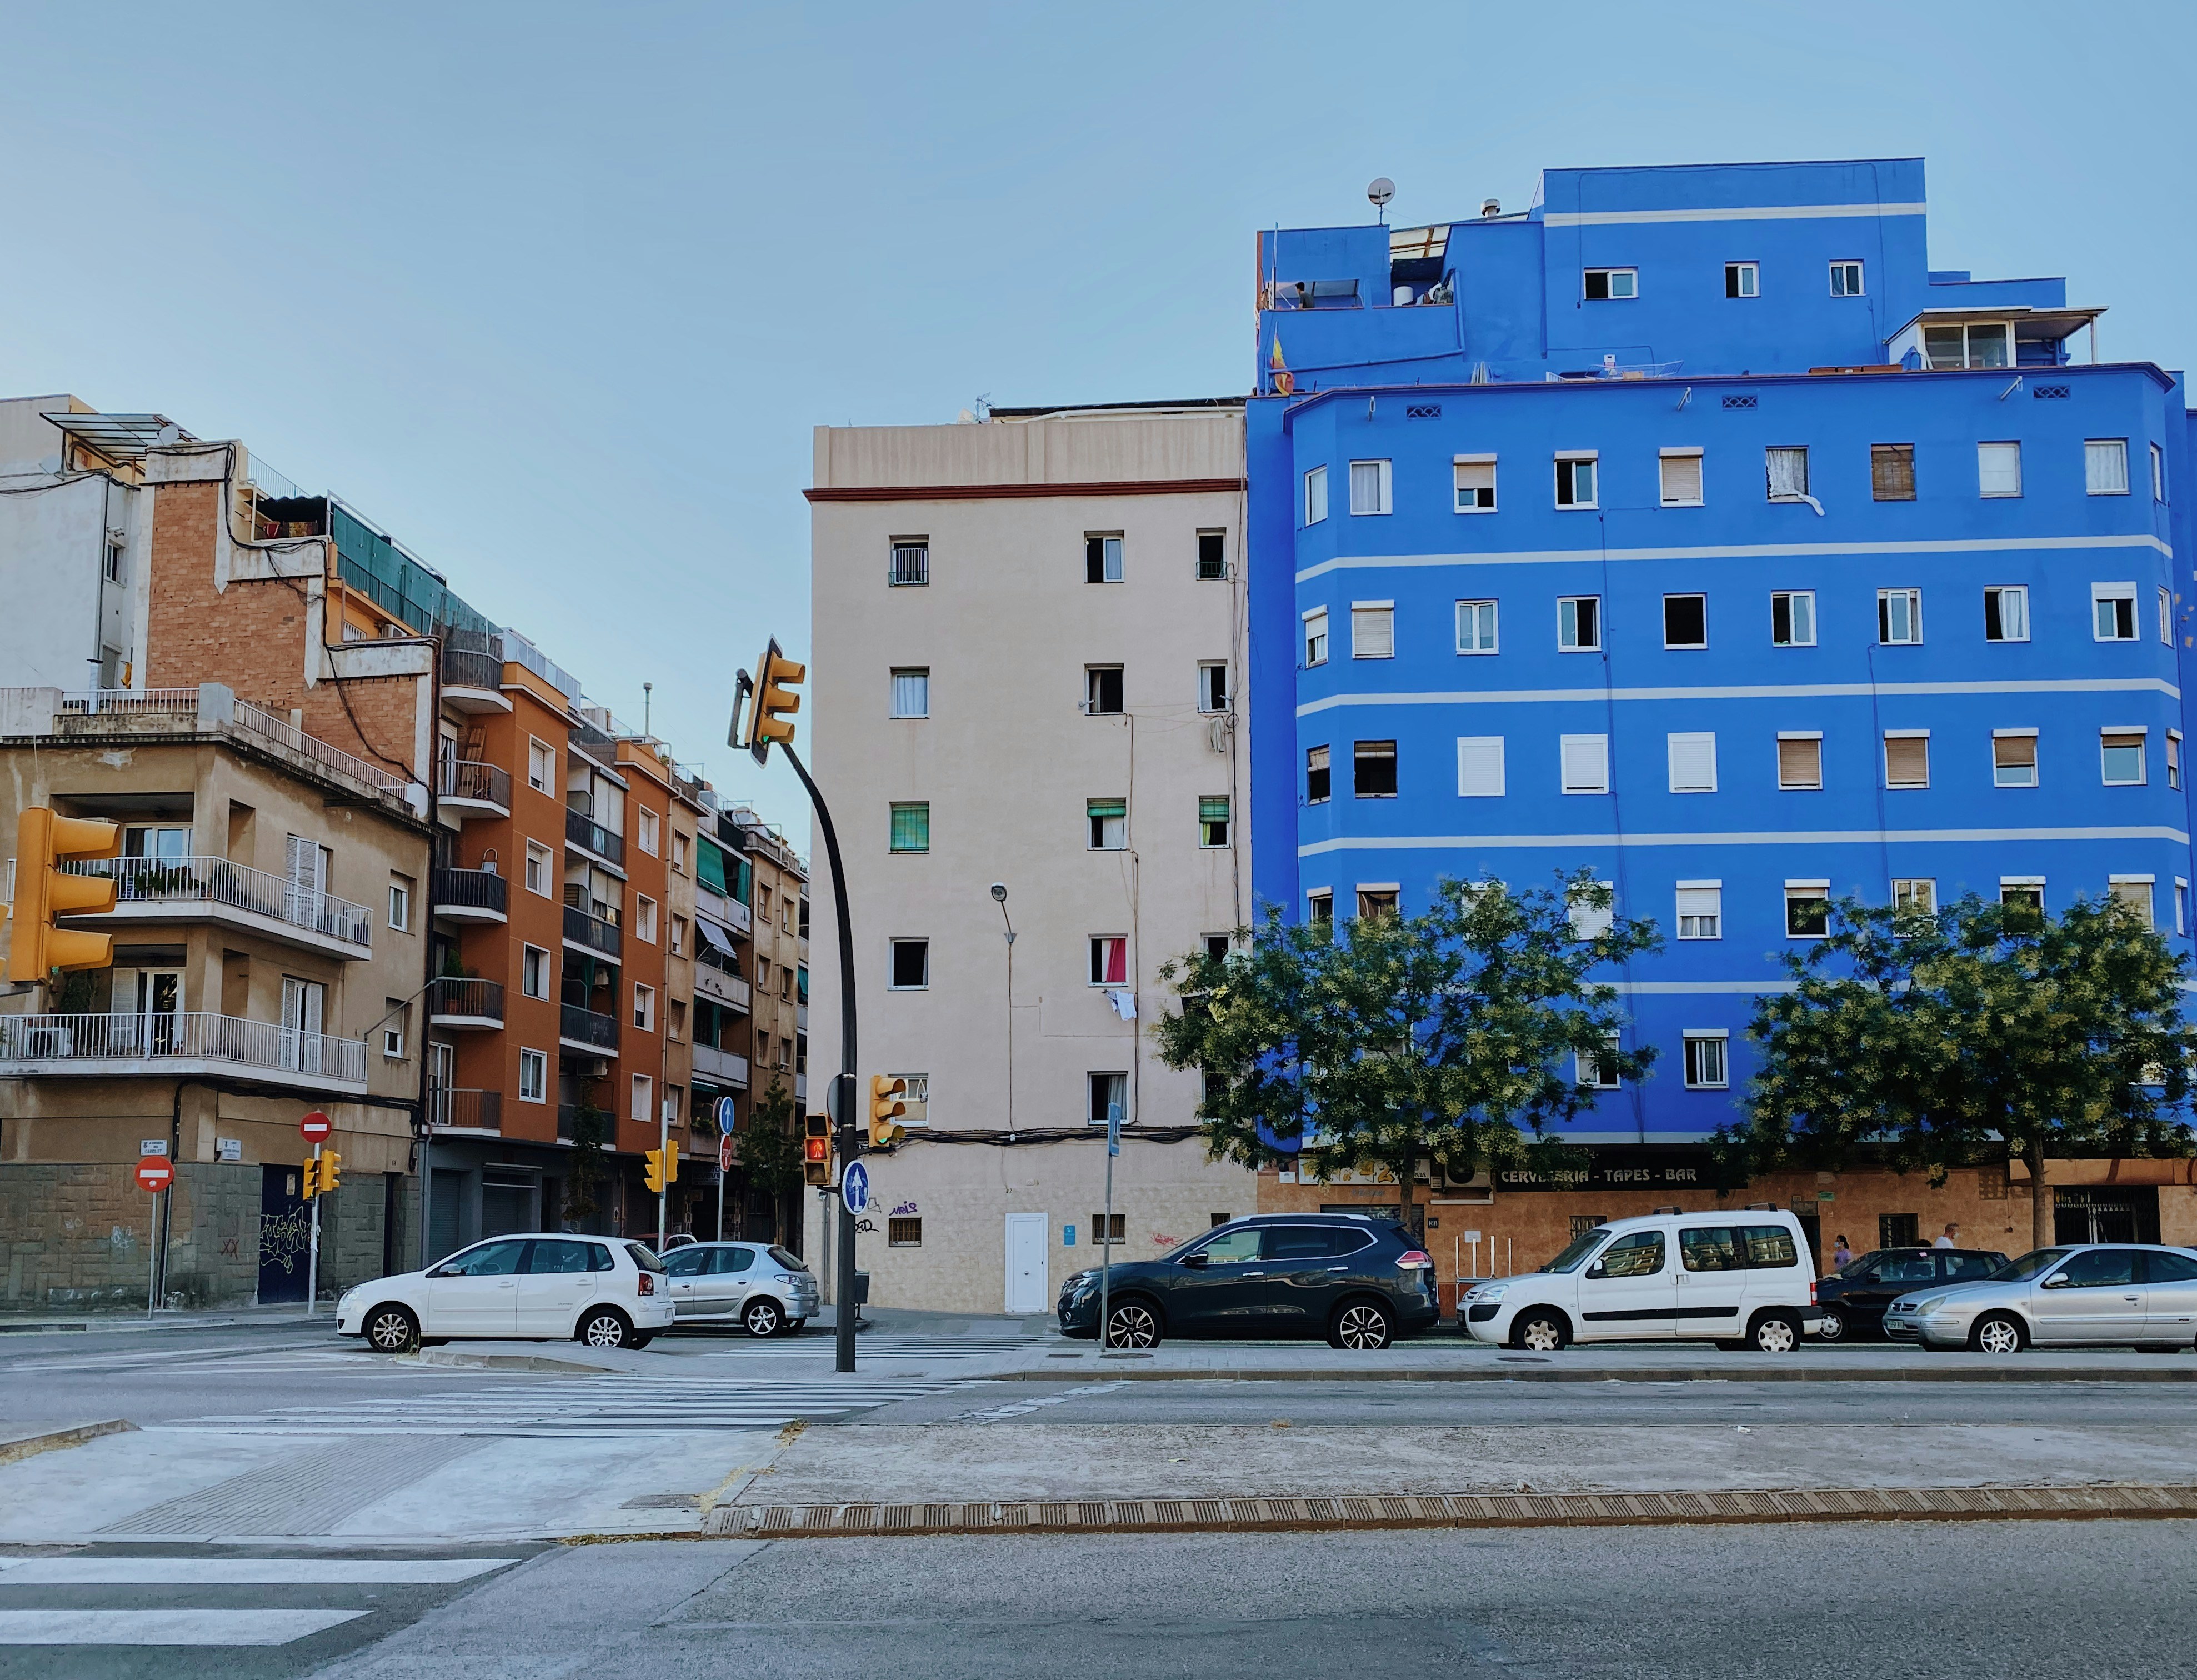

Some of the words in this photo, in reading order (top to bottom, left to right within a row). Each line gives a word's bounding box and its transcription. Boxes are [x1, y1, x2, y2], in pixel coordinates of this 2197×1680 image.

[1501, 1169, 1589, 1183] CERVEERIA
[1604, 1169, 1650, 1182] TAPES
[1665, 1168, 1697, 1182] BAR
